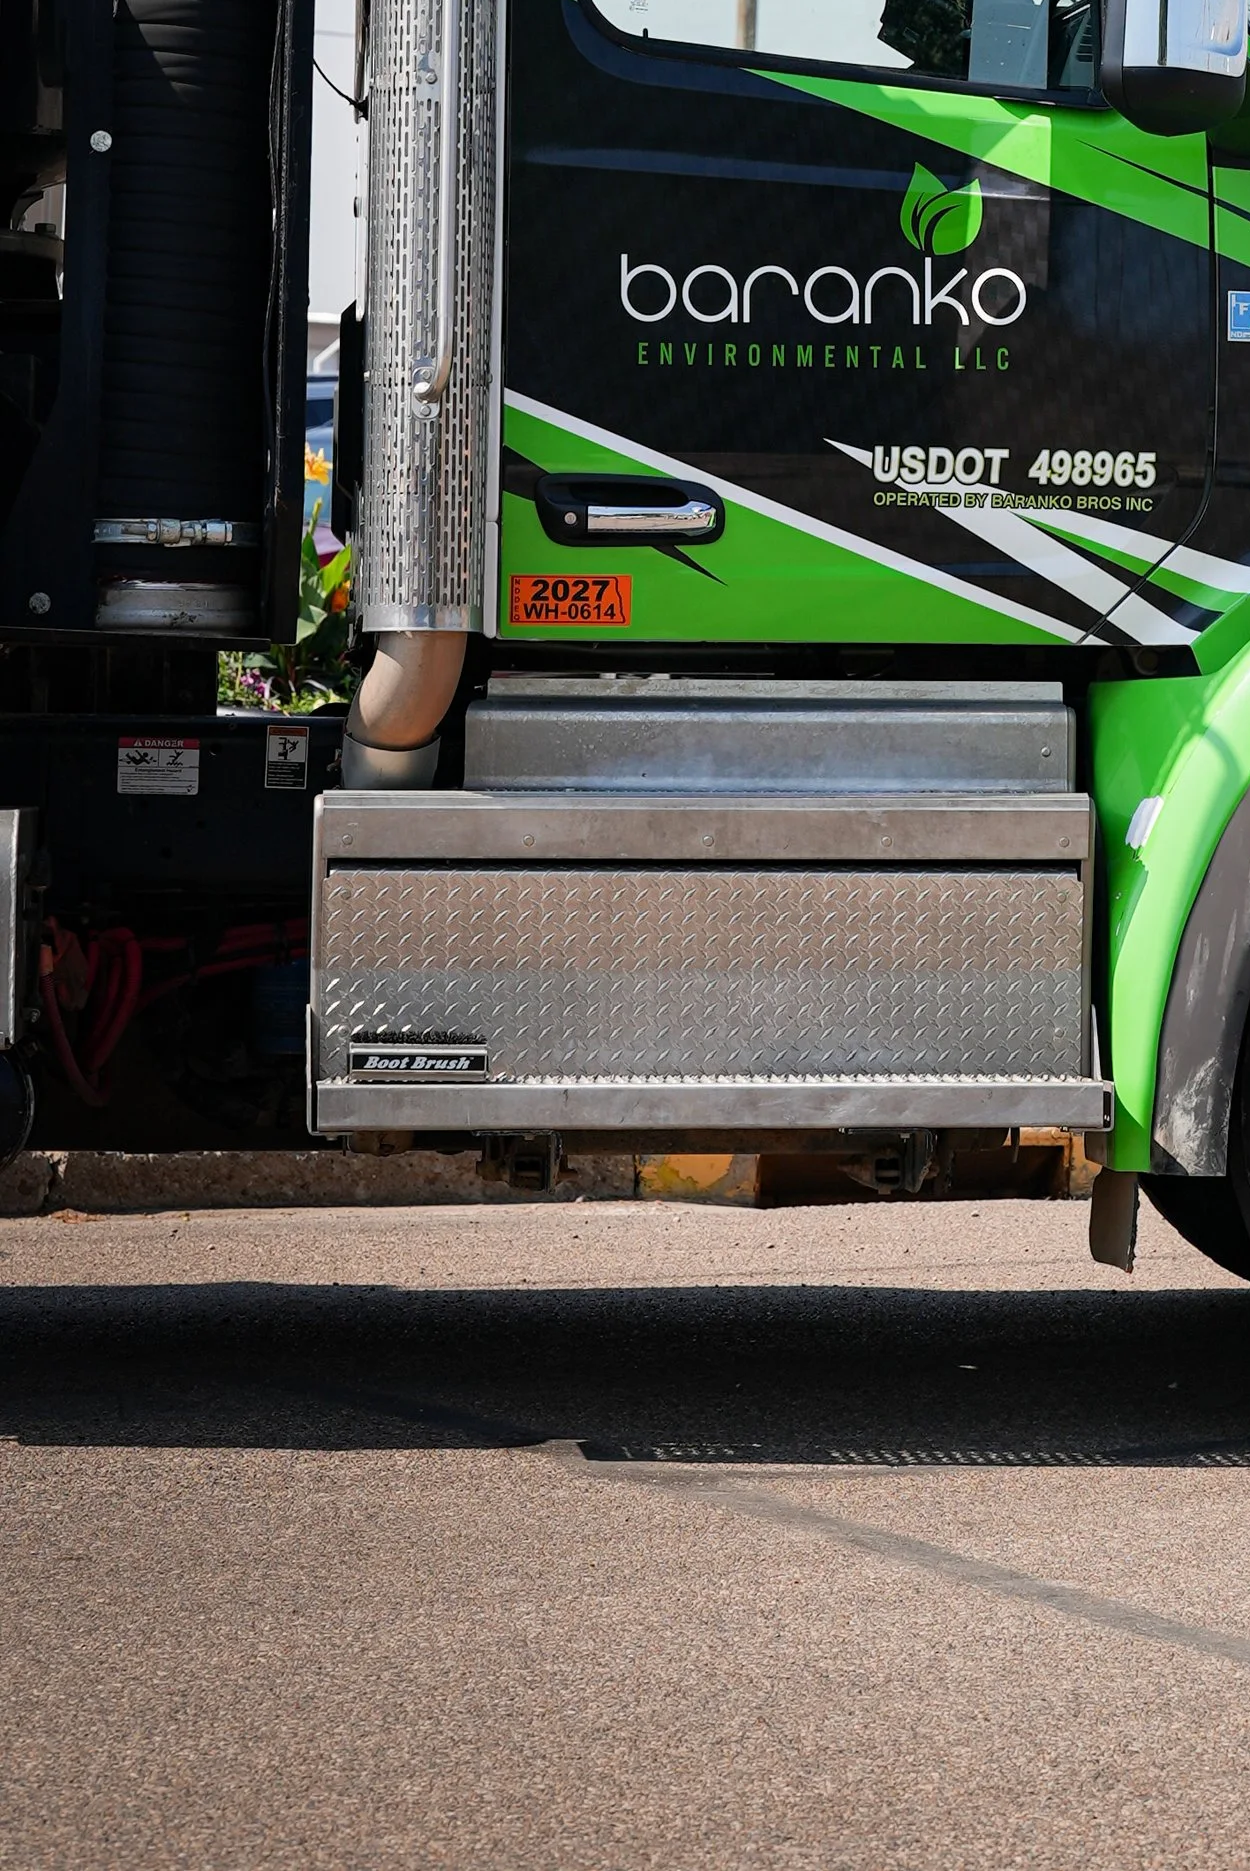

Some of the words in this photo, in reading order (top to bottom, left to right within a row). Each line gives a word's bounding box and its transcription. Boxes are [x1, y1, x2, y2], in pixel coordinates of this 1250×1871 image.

[621, 253, 1027, 326] baranko
[638, 342, 926, 369] ENVIRONMENTAL
[955, 347, 1010, 370] LLC
[873, 445, 1010, 485] USDOT
[1028, 449, 1157, 488] 498965
[873, 492, 960, 507] OPERATED
[964, 494, 988, 508] BY
[991, 495, 1073, 510] BARANKO
[1076, 496, 1122, 510] BROS
[1126, 497, 1154, 512] INC
[531, 579, 610, 602] 2027
[524, 603, 616, 620] WH-0614
[144, 739, 184, 747] DANGER
[364, 1056, 409, 1069] Boot
[410, 1056, 470, 1070] Brush
